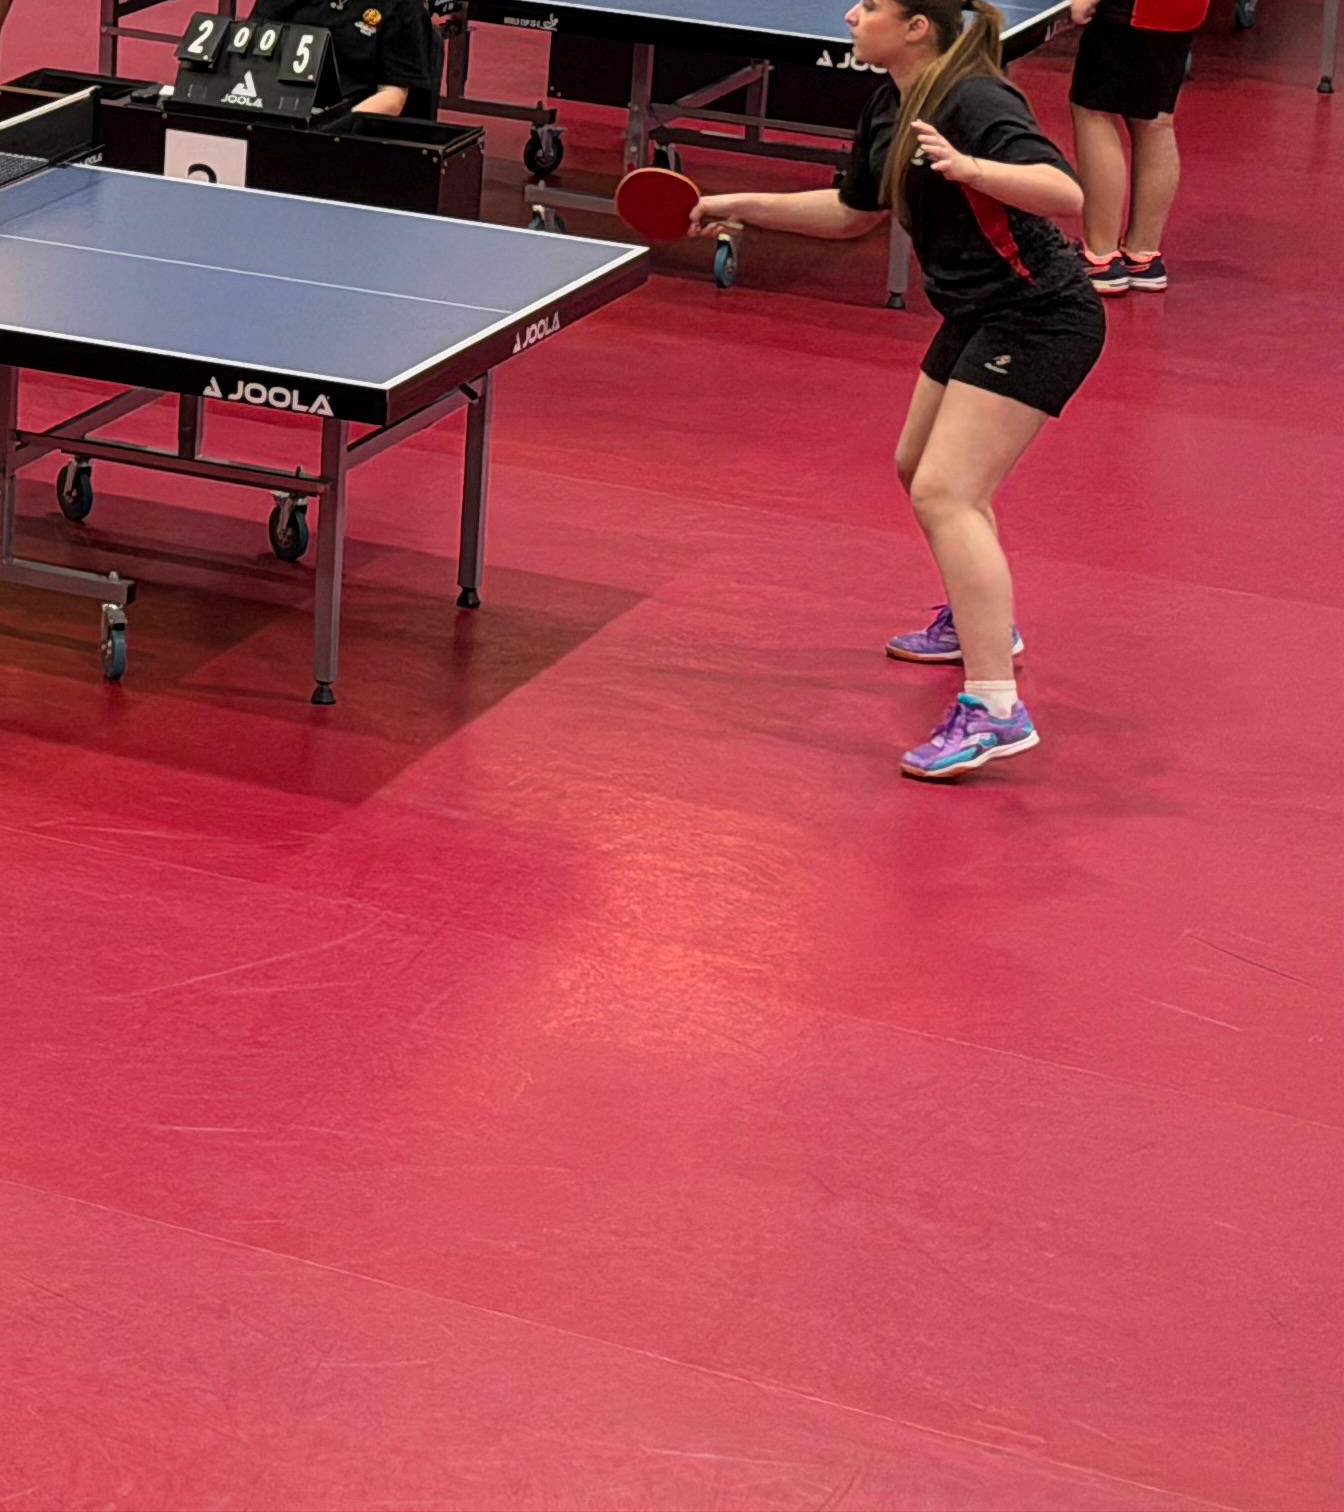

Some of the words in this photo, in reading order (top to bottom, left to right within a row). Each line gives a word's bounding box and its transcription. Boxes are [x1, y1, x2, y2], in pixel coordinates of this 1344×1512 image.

[187, 19, 214, 54] 2
[233, 26, 250, 48] 0
[259, 29, 276, 51] 0
[292, 34, 314, 74] 5
[221, 93, 264, 109] JOOLA
[522, 311, 561, 349] JOOLA
[227, 380, 335, 417] JOOLA
